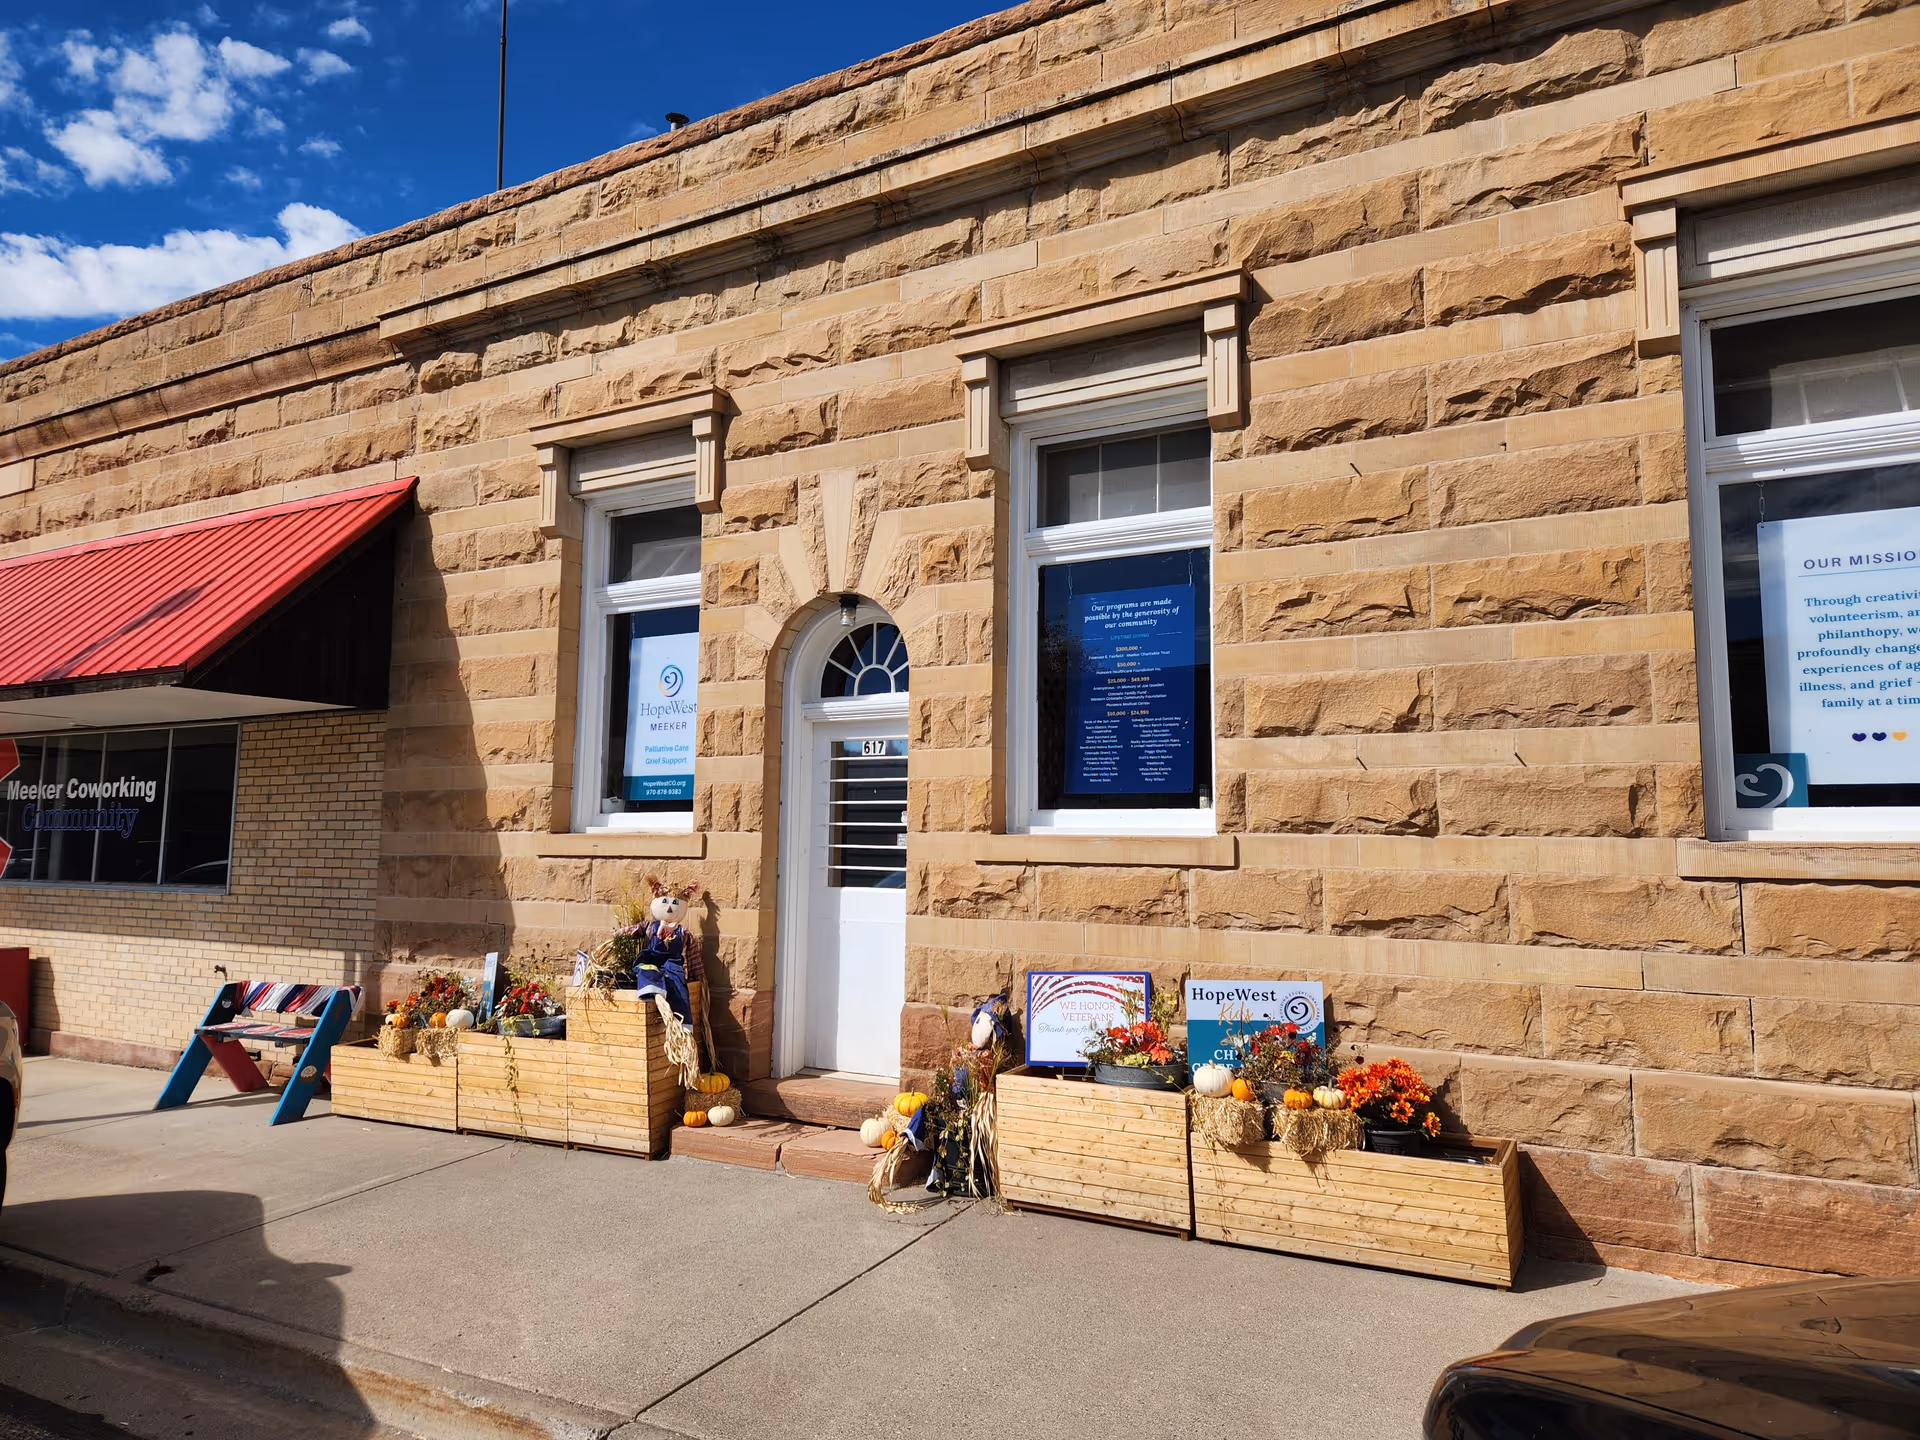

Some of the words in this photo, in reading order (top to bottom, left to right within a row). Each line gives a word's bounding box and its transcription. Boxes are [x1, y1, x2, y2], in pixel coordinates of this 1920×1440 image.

[1804, 558, 1841, 570] OUR
[1850, 550, 1920, 567] MISSIO
[1804, 595, 1861, 608] Through
[1866, 590, 1920, 603] creativi
[1106, 602, 1138, 612] programs
[1084, 611, 1111, 623] possible
[1112, 611, 1120, 620] by
[1134, 608, 1170, 619] generosity
[1172, 606, 1180, 615] of
[1809, 610, 1903, 624] volunteerism,
[1118, 619, 1157, 628] community
[1818, 627, 1902, 642] philanthopy,
[1797, 645, 1870, 662] profoundly
[1803, 663, 1884, 676] experiences
[1888, 660, 1902, 670] of
[1799, 681, 1846, 692] illness,
[1850, 680, 1874, 690] and
[1879, 678, 1912, 691] grief
[640, 700, 697, 718] HopeWest
[1822, 697, 1863, 709] family
[1868, 698, 1881, 706] at
[650, 722, 687, 731] MEEKER
[864, 741, 884, 754] 617
[661, 757, 687, 765] Support
[7, 780, 64, 800] Meeker
[66, 776, 157, 802] Coworking
[22, 801, 139, 838] Community
[1192, 988, 1277, 1004] HopeWest
[1060, 1001, 1076, 1010] WE
[1080, 1001, 1116, 1010] HONOR
[1062, 1012, 1114, 1021] VETERANS
[1218, 1002, 1254, 1026] Kids
[1038, 1022, 1065, 1034] Thank
[1064, 1027, 1079, 1035] you
[1079, 1025, 1091, 1035] fo
